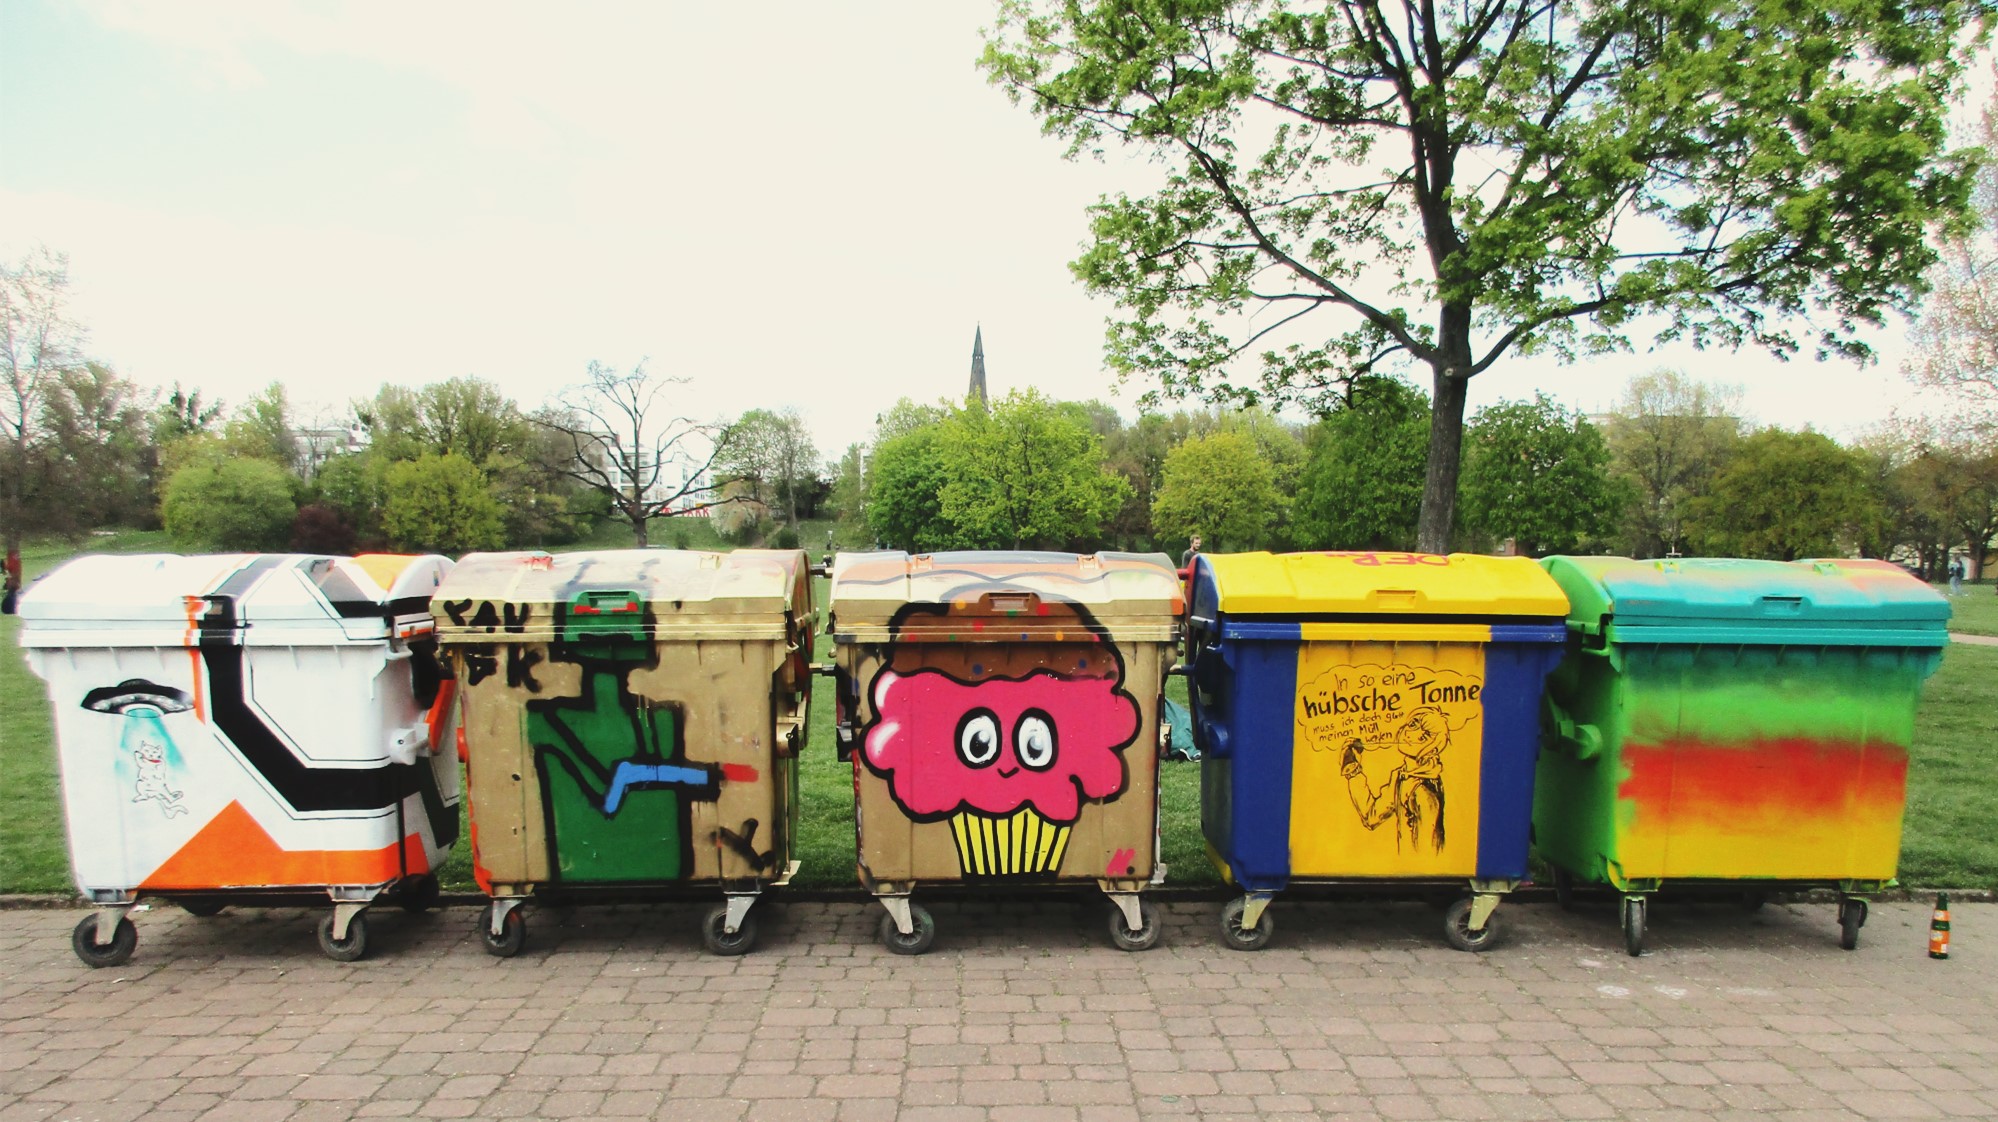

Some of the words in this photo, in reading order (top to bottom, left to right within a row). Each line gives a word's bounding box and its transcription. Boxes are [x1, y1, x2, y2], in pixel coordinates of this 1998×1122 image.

[1334, 673, 1348, 691] In
[1358, 674, 1375, 689] so
[1382, 667, 1416, 686] eine
[1303, 687, 1402, 719] hübsche
[1408, 680, 1481, 704] Tonne
[1341, 716, 1355, 728] ich
[1359, 711, 1382, 723] doch
[1358, 721, 1380, 735] Müll
